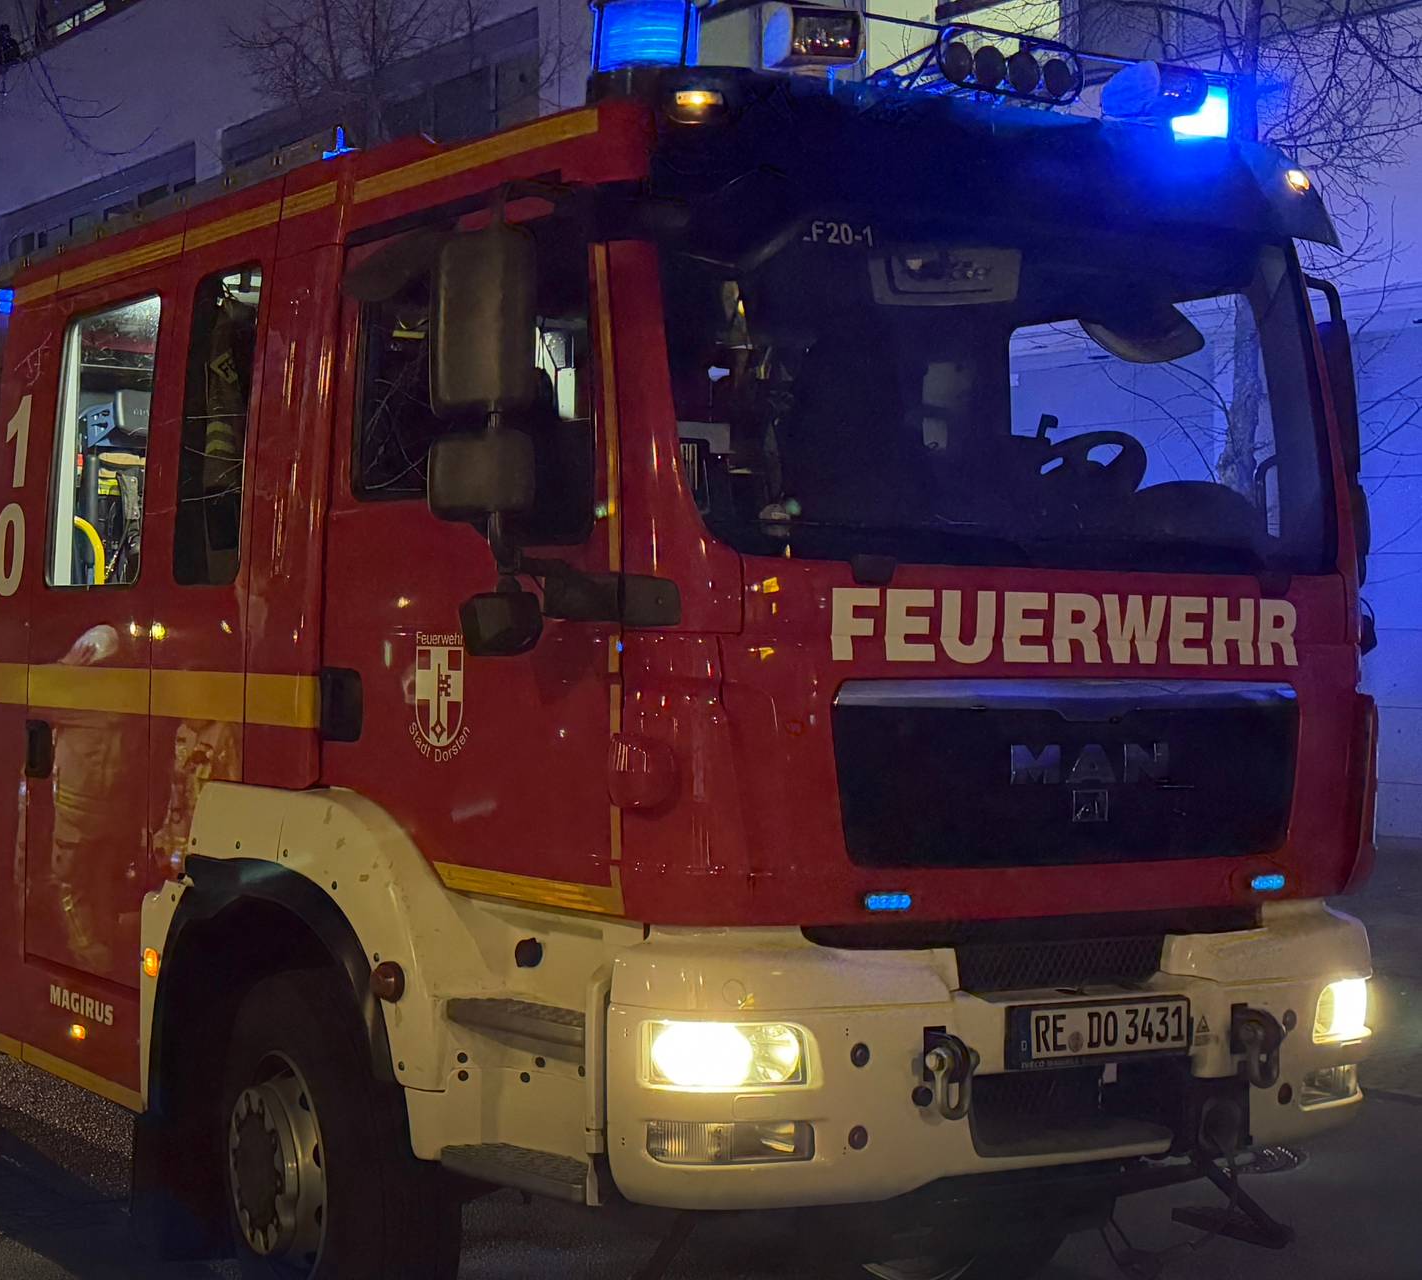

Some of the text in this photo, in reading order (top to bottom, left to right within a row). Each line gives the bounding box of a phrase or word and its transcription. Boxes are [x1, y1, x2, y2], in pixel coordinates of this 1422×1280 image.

[802, 220, 874, 248] F20-1
[416, 631, 464, 646] Feuerwehr
[830, 586, 1299, 667] FEUERWEHR
[408, 722, 471, 762] Stadt Dorsten
[1009, 741, 1170, 785] MAN
[50, 984, 114, 1026] MAGIRUS
[1034, 1014, 1067, 1053] RE
[1087, 1010, 1119, 1049] DO
[1125, 1006, 1185, 1045] 3431
